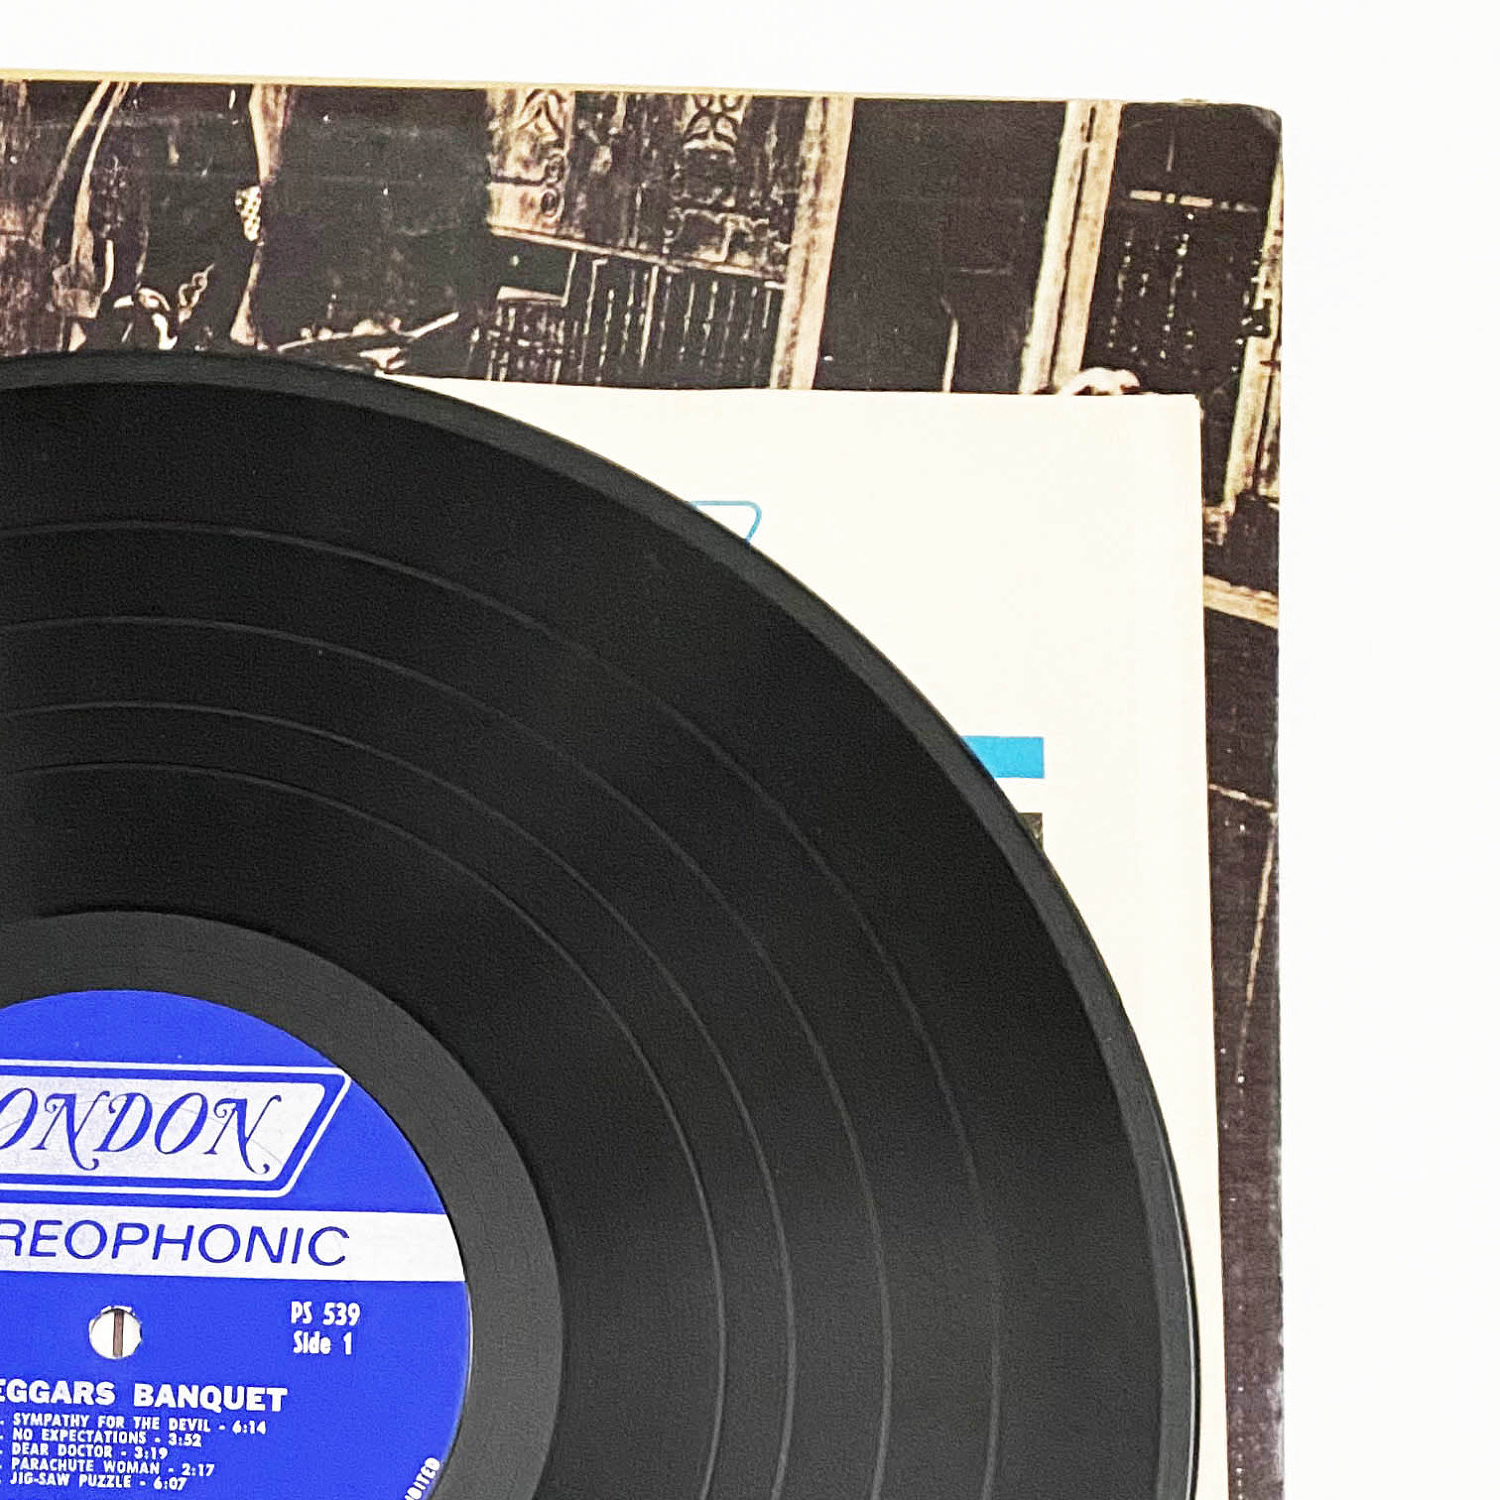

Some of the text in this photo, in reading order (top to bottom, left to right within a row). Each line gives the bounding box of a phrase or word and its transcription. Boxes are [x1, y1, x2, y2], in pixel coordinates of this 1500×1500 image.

[291, 1301, 361, 1326] PS 539
[293, 1330, 352, 1355] Side 1
[133, 1383, 288, 1414] BANQUET
[13, 1412, 90, 1428] SYMPATHY
[97, 1415, 125, 1429] FOR
[133, 1416, 160, 1430] THE
[168, 1417, 211, 1433] DEVIL
[232, 1420, 267, 1435] 6:14
[12, 1427, 33, 1441] NO
[41, 1428, 147, 1445] EXPECTATIONS
[168, 1432, 202, 1447] 3:52
[11, 1441, 49, 1456] DEAR
[57, 1443, 113, 1459] DOCTOR
[134, 1445, 168, 1460] 3:19
[11, 1456, 94, 1473] PARACHUTE
[103, 1460, 160, 1475] WOMAN
[181, 1463, 215, 1477] 2:17
[9, 1471, 70, 1486] JIG-SAW
[78, 1473, 132, 1489] PUZZLE
[153, 1476, 187, 1491] 6:07
